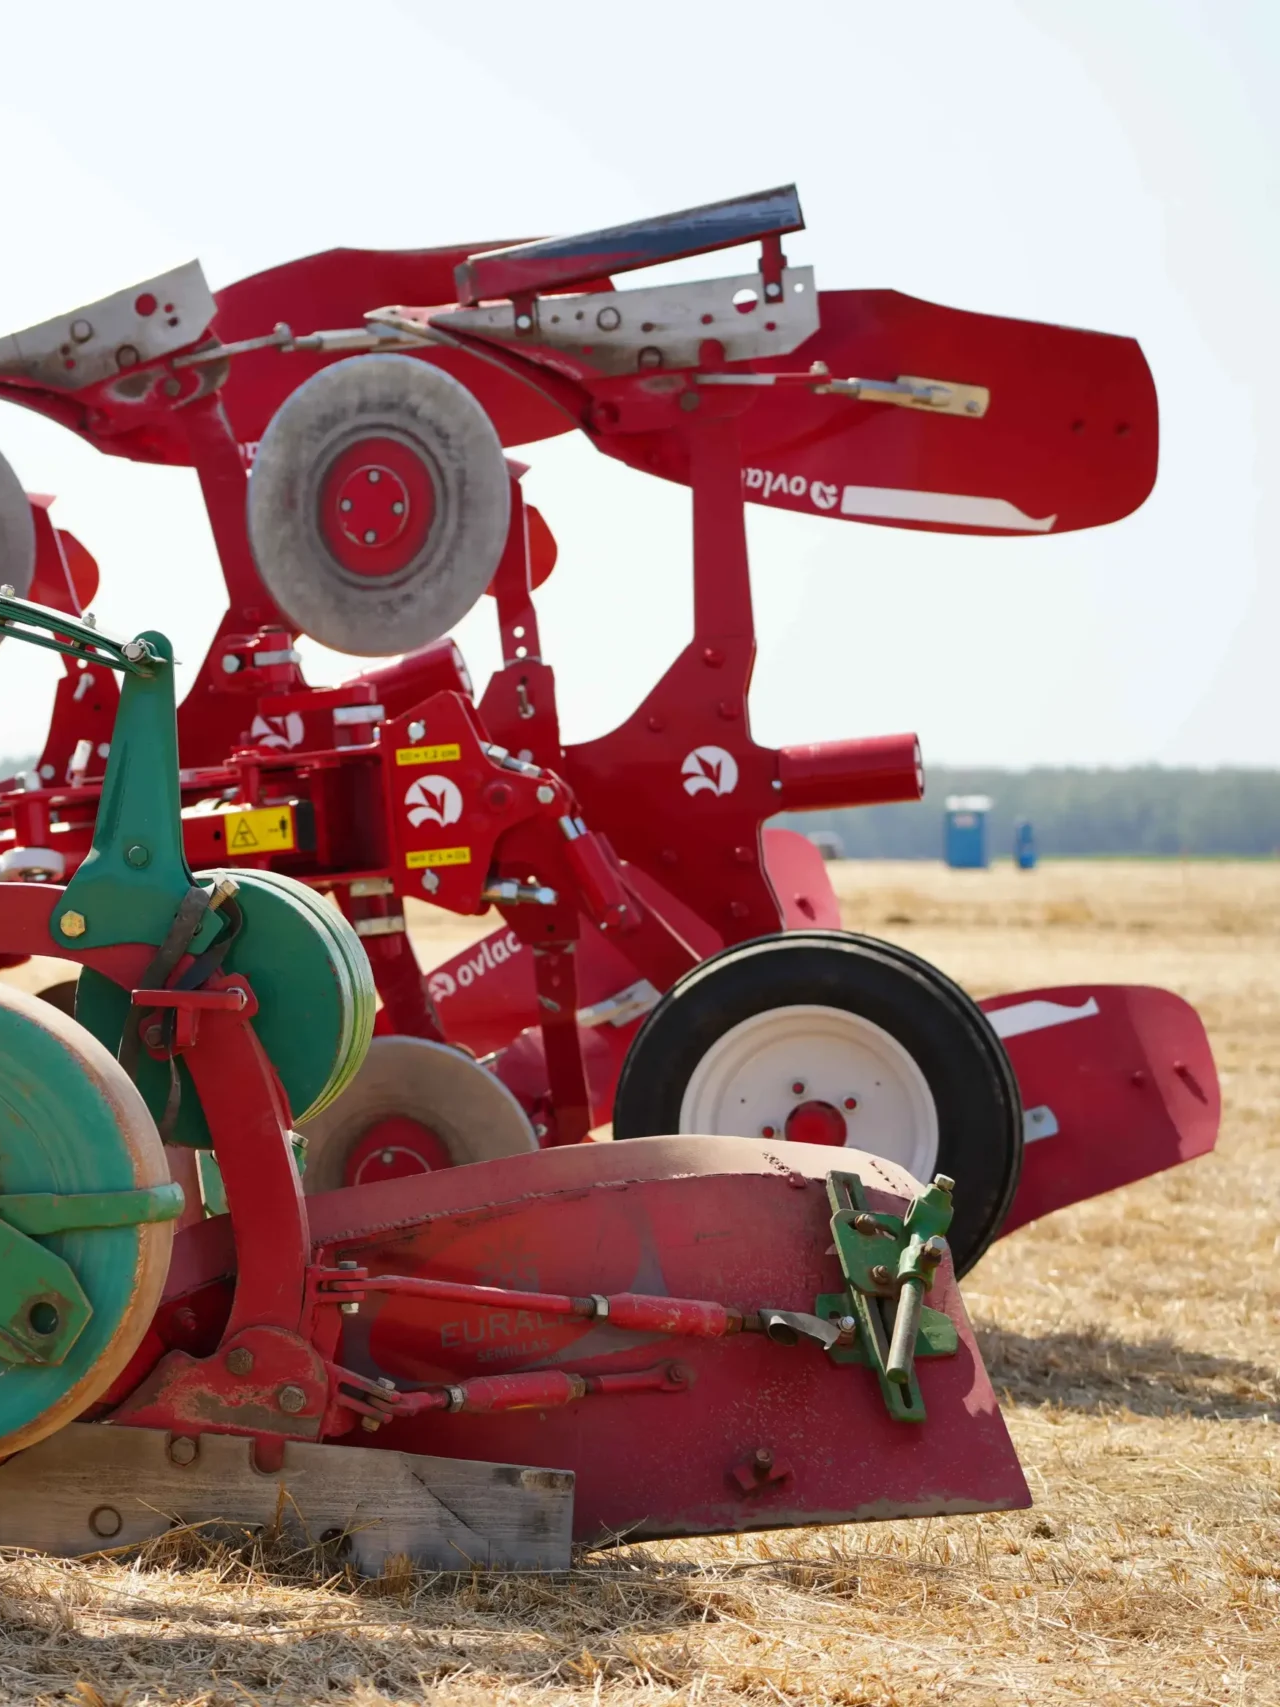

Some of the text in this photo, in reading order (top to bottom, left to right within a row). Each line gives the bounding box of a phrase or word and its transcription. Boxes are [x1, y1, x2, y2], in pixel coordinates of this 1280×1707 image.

[457, 931, 522, 987] ovlac
[441, 1311, 585, 1348] EURAL
[477, 1338, 549, 1363] SEMILLAS
